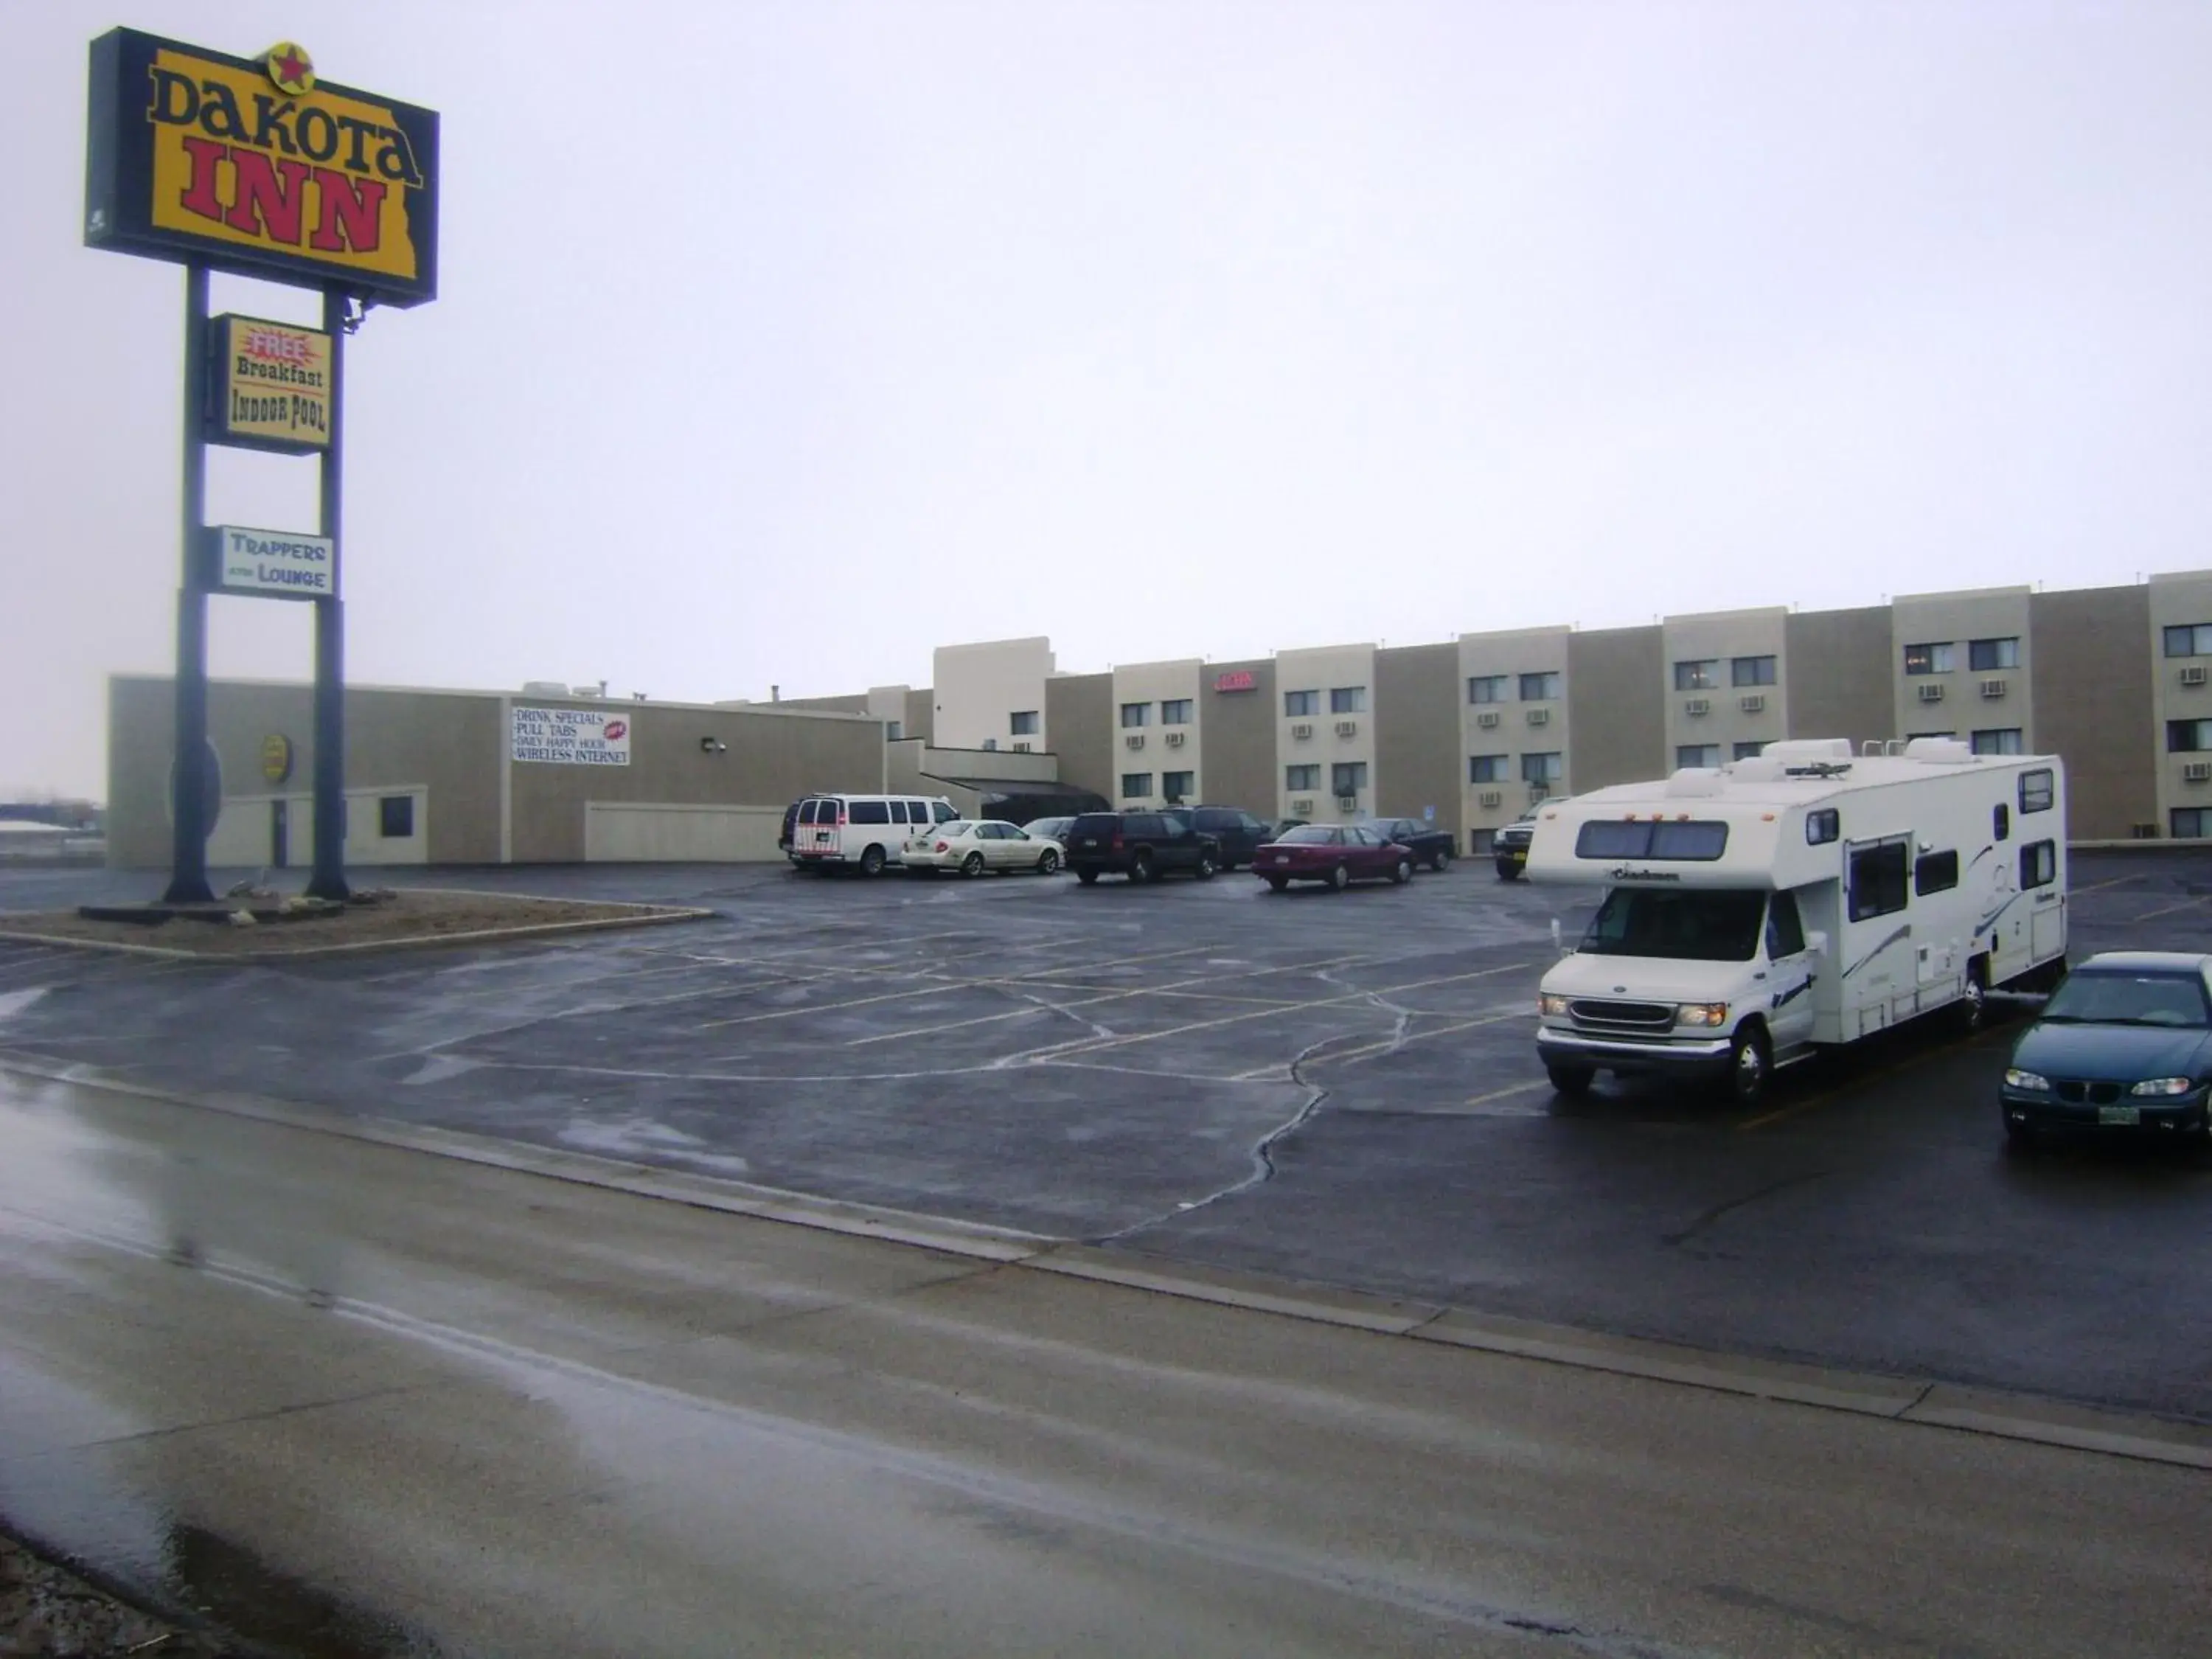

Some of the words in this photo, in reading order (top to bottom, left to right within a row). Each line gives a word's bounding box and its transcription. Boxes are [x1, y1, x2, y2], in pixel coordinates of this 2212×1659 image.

[181, 135, 387, 255] INN
[249, 333, 305, 358] FREE
[237, 355, 323, 387] Breakfast
[232, 389, 288, 422] INDOOR
[291, 394, 325, 432] POOL
[230, 533, 326, 561] TRAPPERS
[258, 563, 327, 588] LOUNGE
[517, 709, 551, 723] DRINK
[556, 712, 604, 725] SPECIALS
[517, 723, 544, 735] PULL
[549, 724, 577, 737] TABS
[517, 748, 572, 761] WIRELESS
[576, 750, 627, 763] INTERNET
